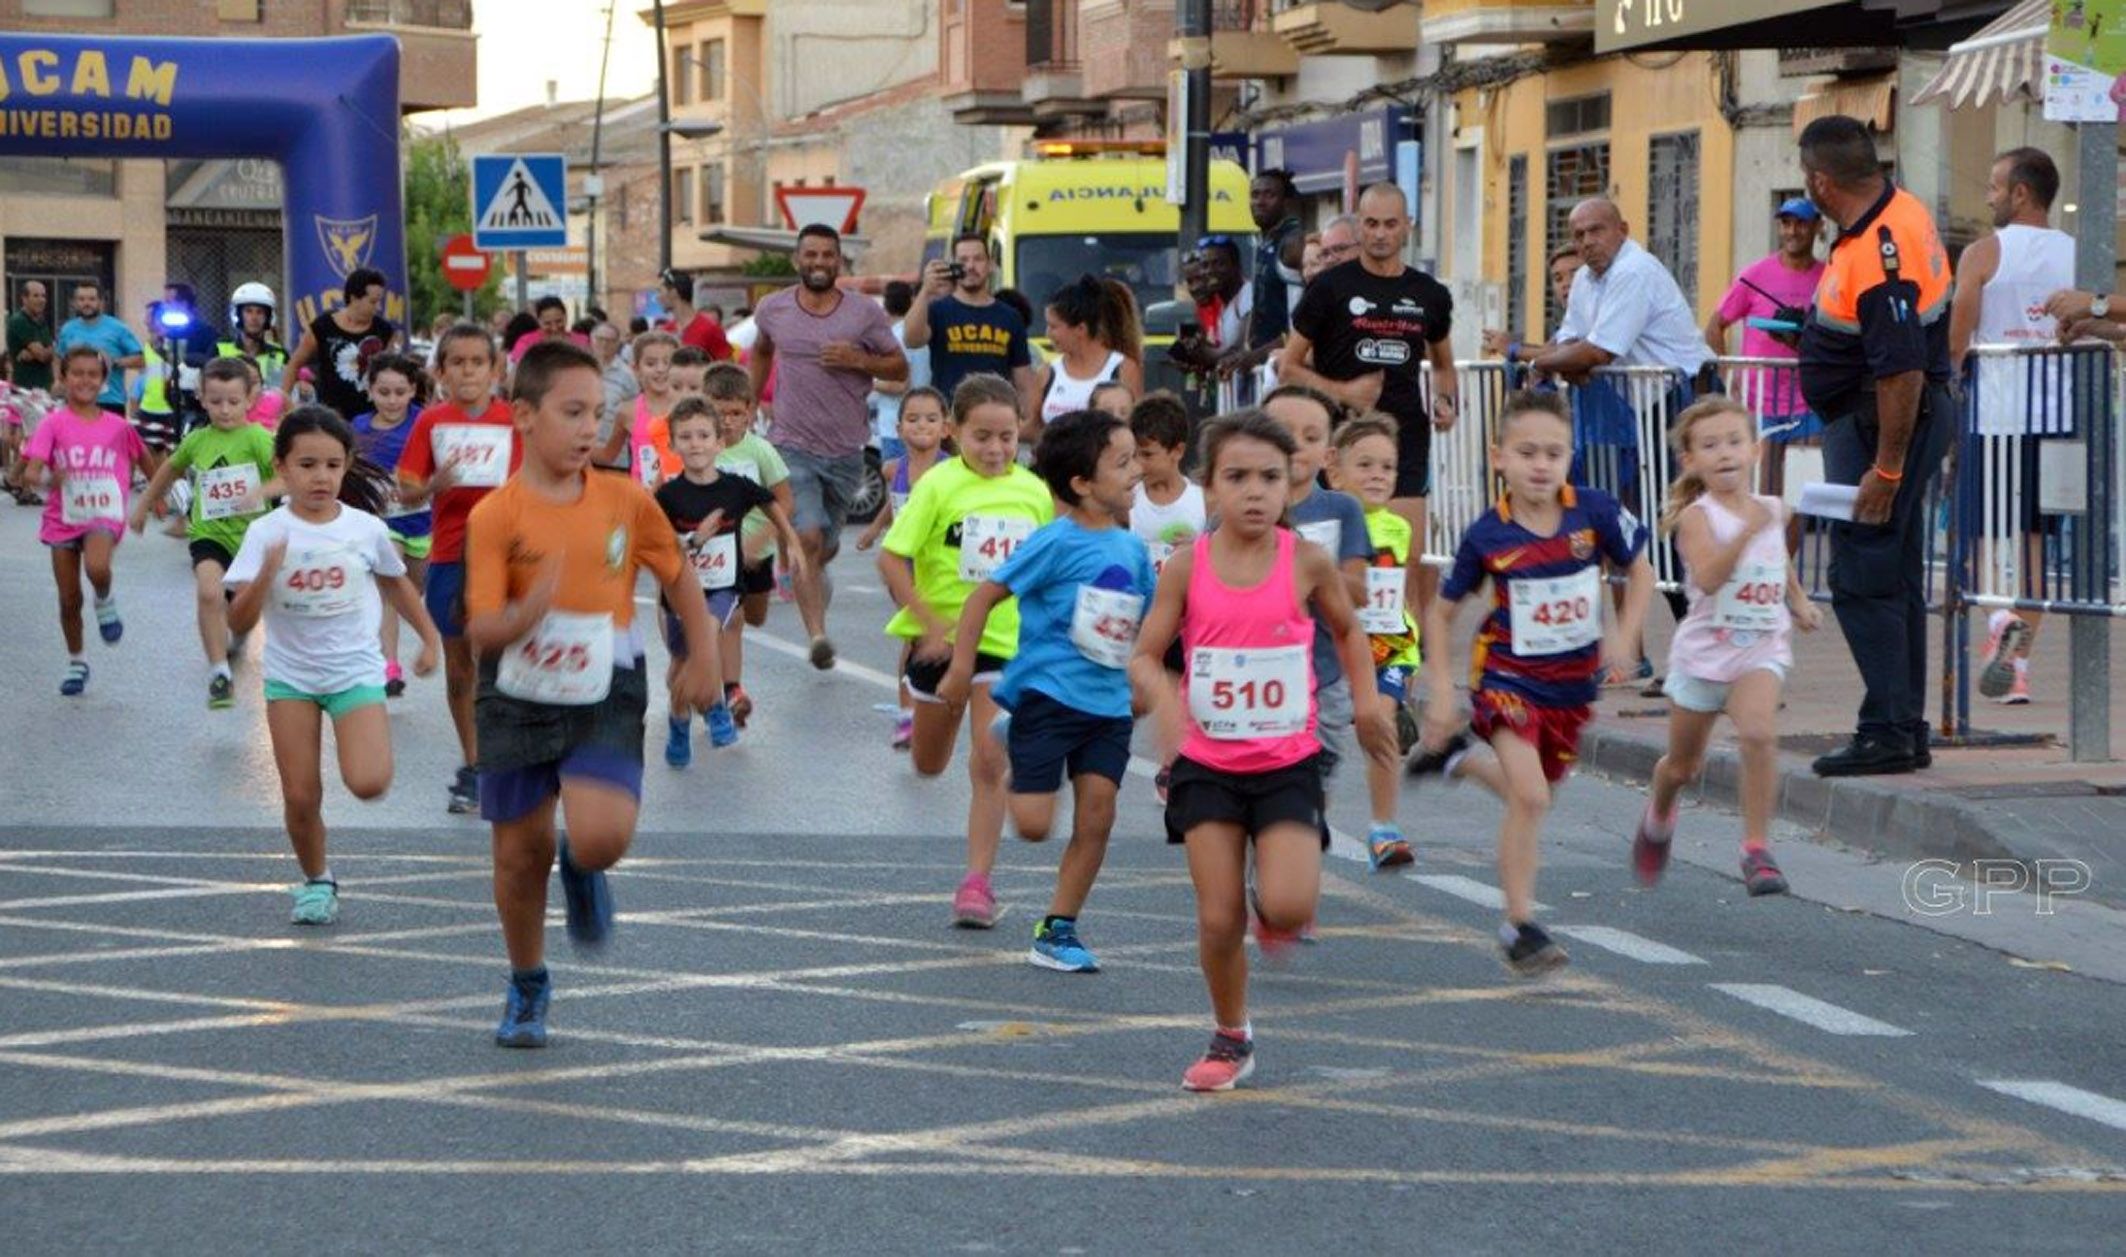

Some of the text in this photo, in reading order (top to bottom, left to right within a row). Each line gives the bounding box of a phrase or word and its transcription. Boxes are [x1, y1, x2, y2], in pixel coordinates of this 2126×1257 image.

[0, 49, 178, 107] CAM
[0, 109, 172, 140] IVERSIDAD
[947, 323, 1010, 345] UCAM
[53, 445, 117, 470] UCAM
[209, 480, 247, 500] 435
[287, 566, 344, 591] 409
[1374, 588, 1397, 609] 17
[1532, 596, 1590, 625] 420
[1212, 680, 1284, 710] 510
